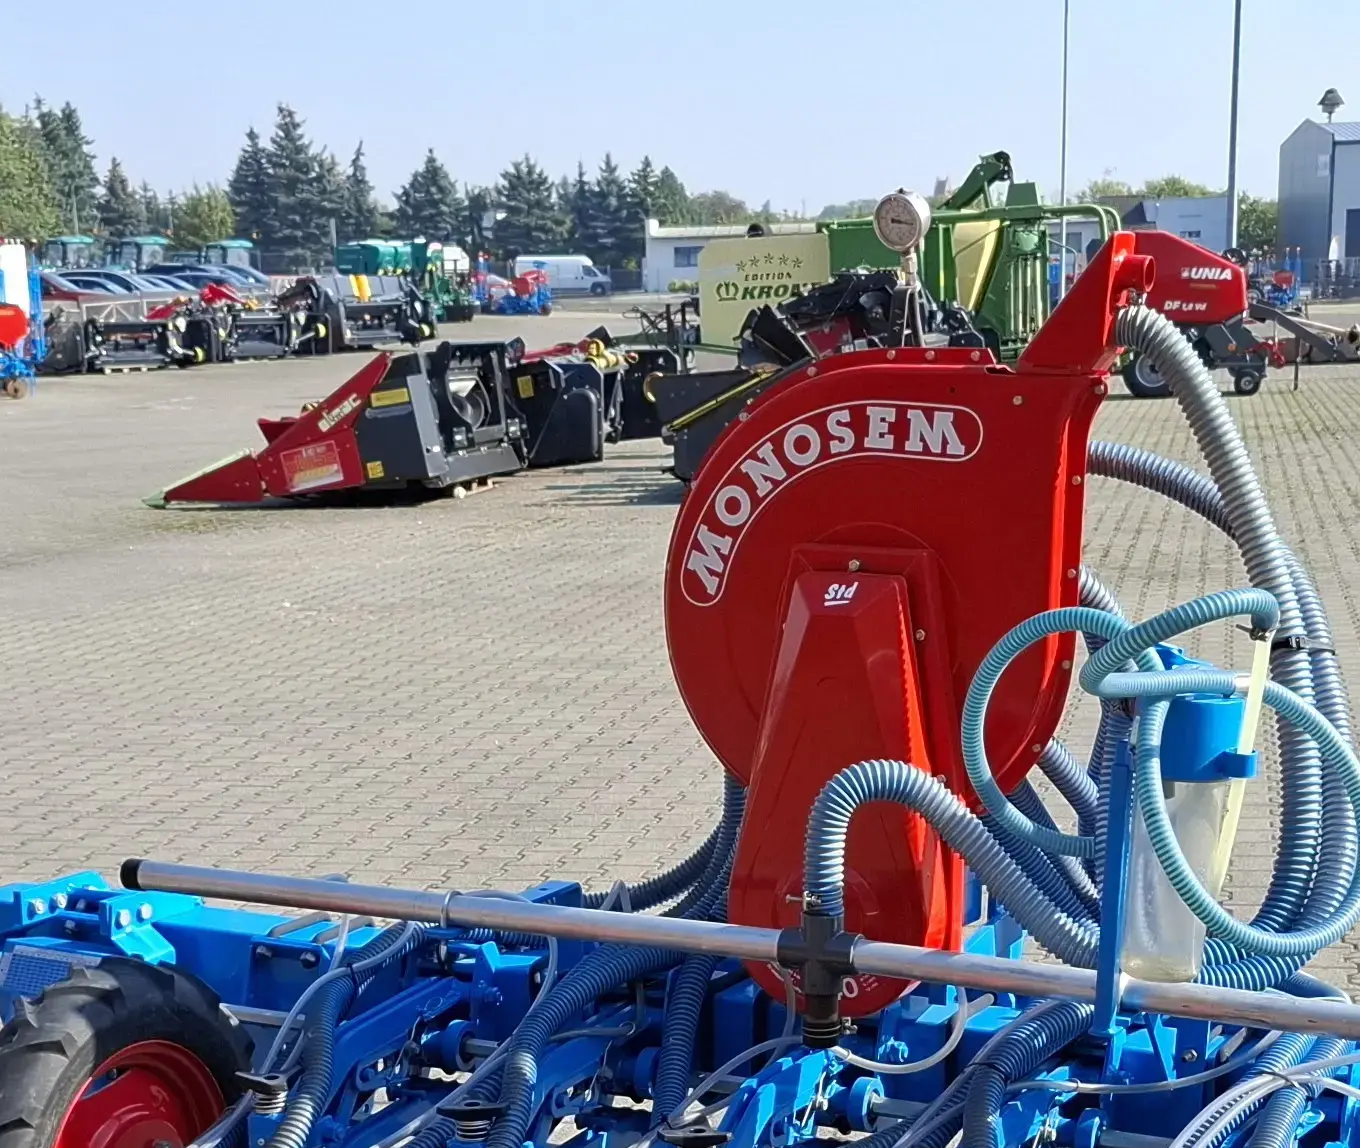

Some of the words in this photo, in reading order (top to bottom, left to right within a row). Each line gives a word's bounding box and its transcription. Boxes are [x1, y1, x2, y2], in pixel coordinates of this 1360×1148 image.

[744, 272, 792, 282] EDITION
[1190, 267, 1232, 280] UNIA
[1163, 300, 1181, 311] DF
[687, 406, 965, 595] MONOSEM
[824, 581, 859, 600] Std
